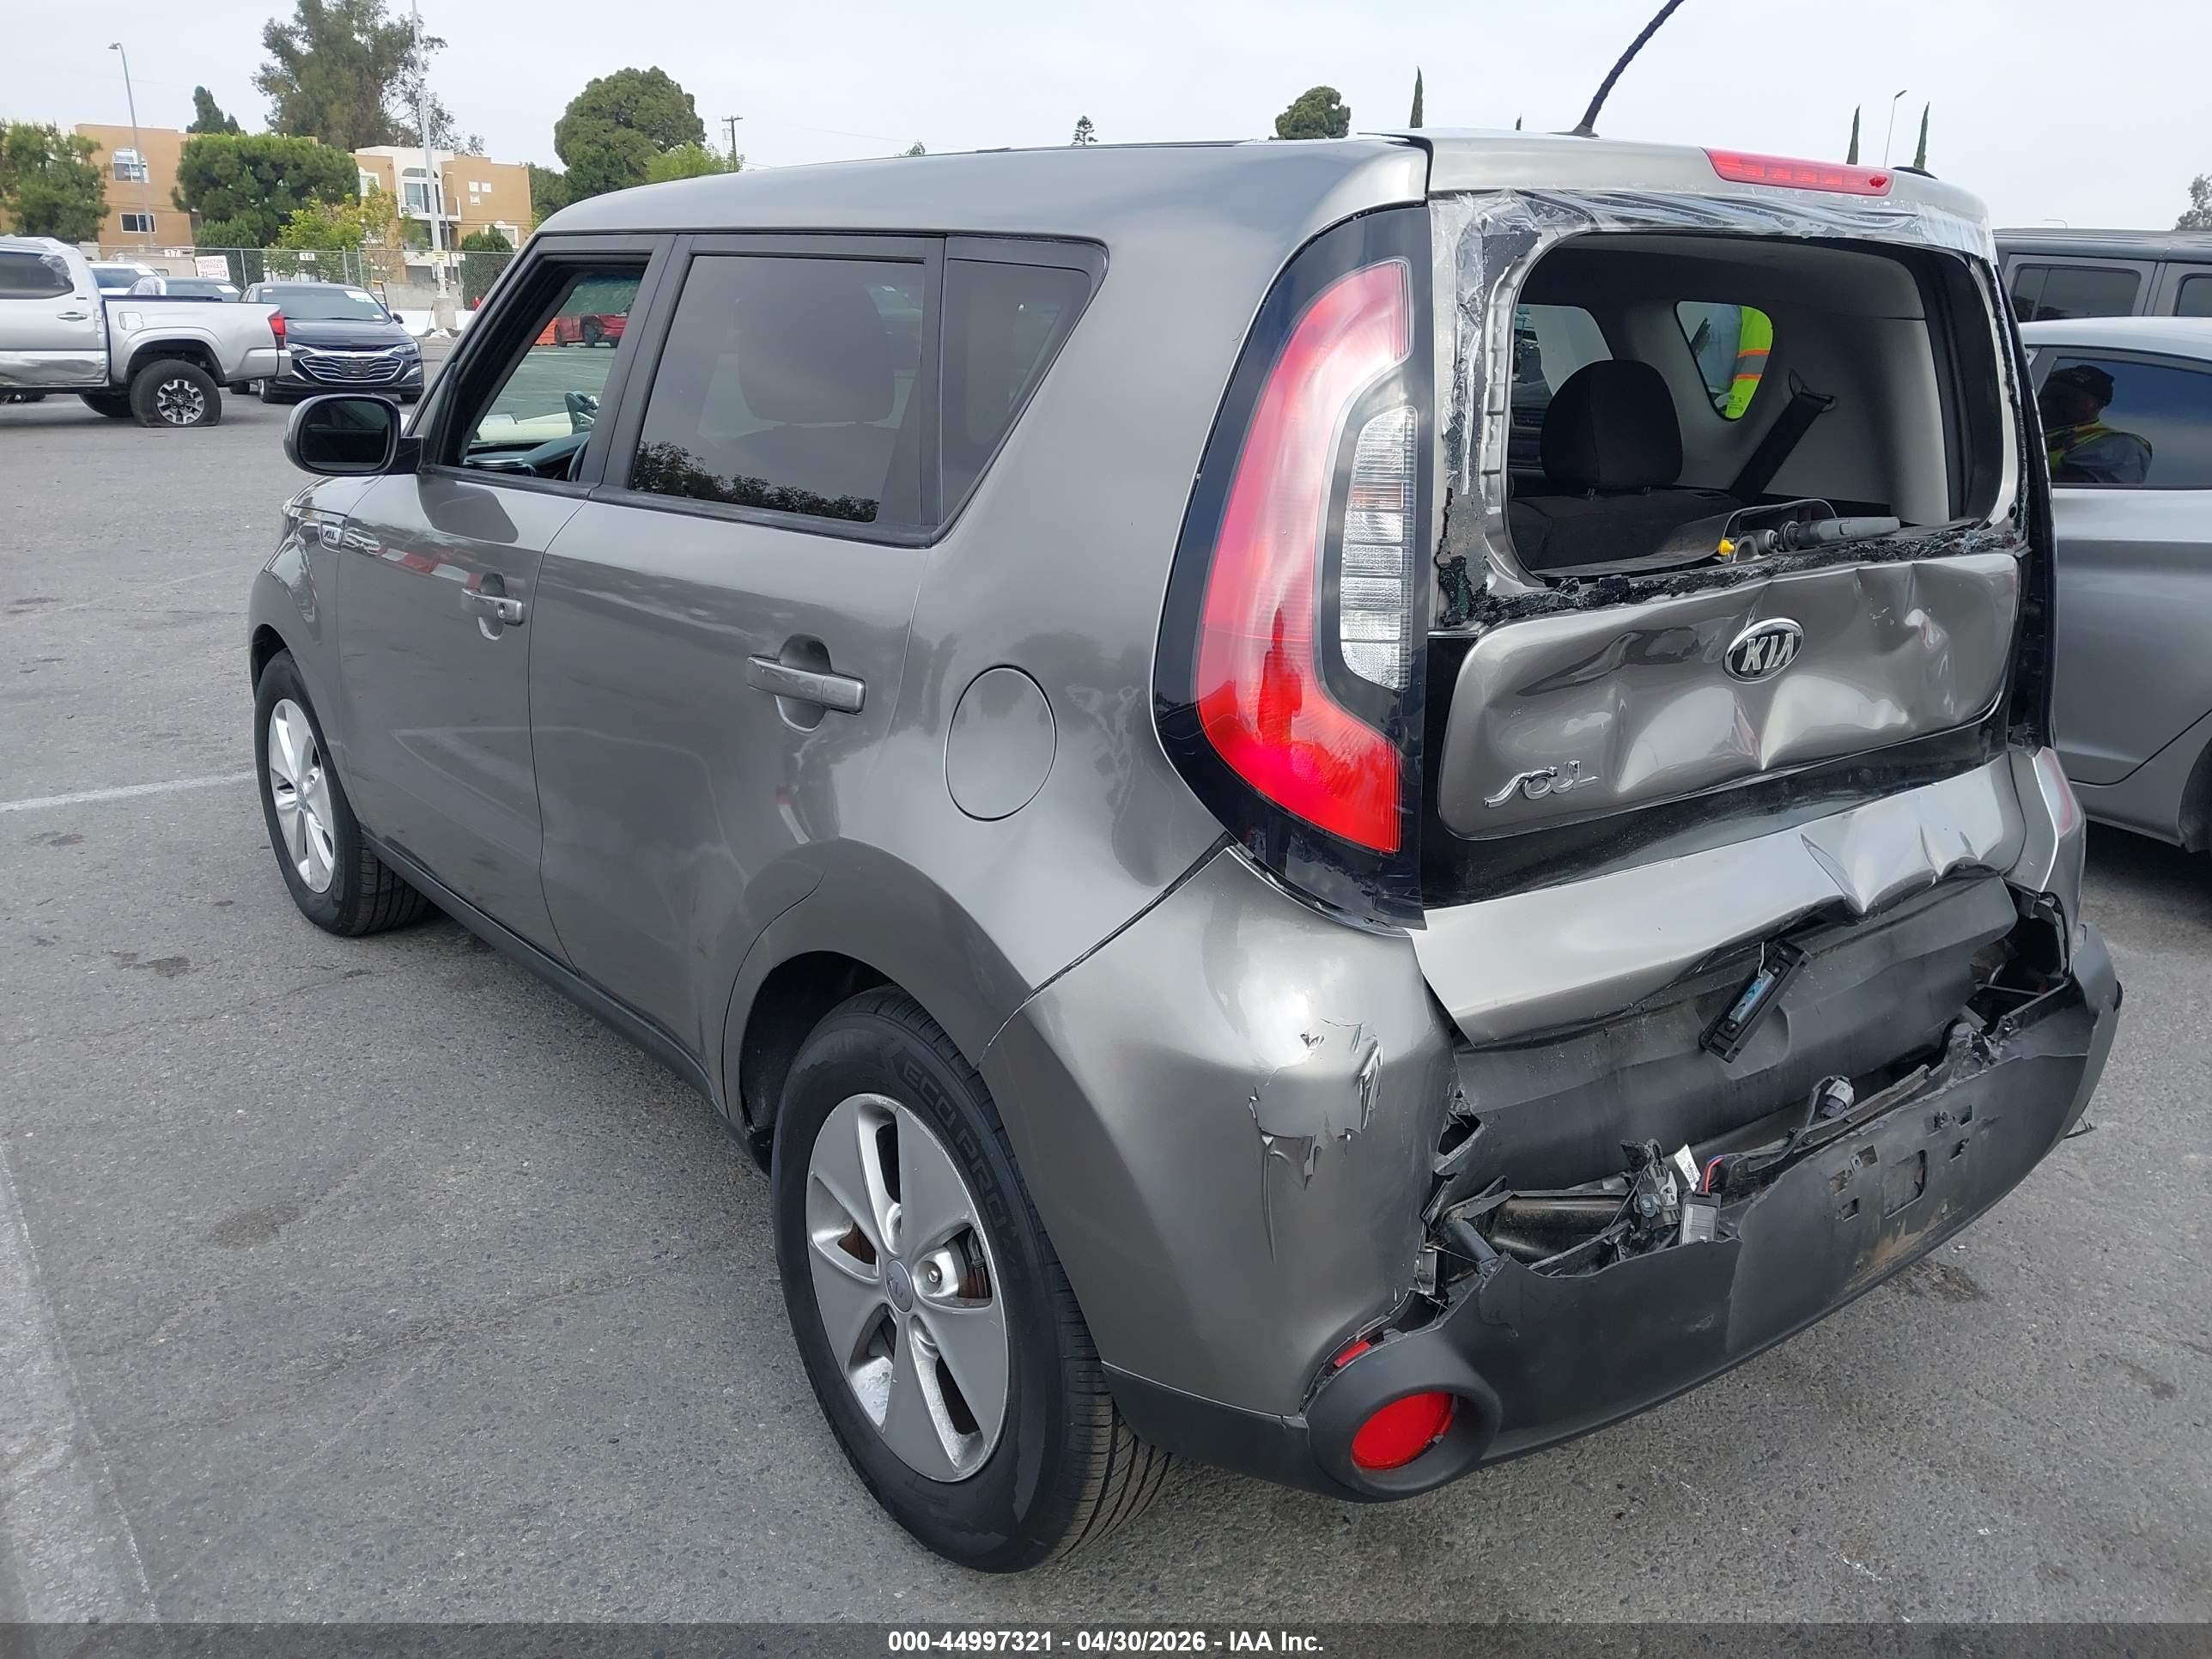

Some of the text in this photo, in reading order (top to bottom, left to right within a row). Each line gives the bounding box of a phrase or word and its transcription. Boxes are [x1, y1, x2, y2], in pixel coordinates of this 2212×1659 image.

[167, 249, 178, 258] 17
[1740, 632, 1795, 672] KIA
[902, 1058, 958, 1128] ECO
